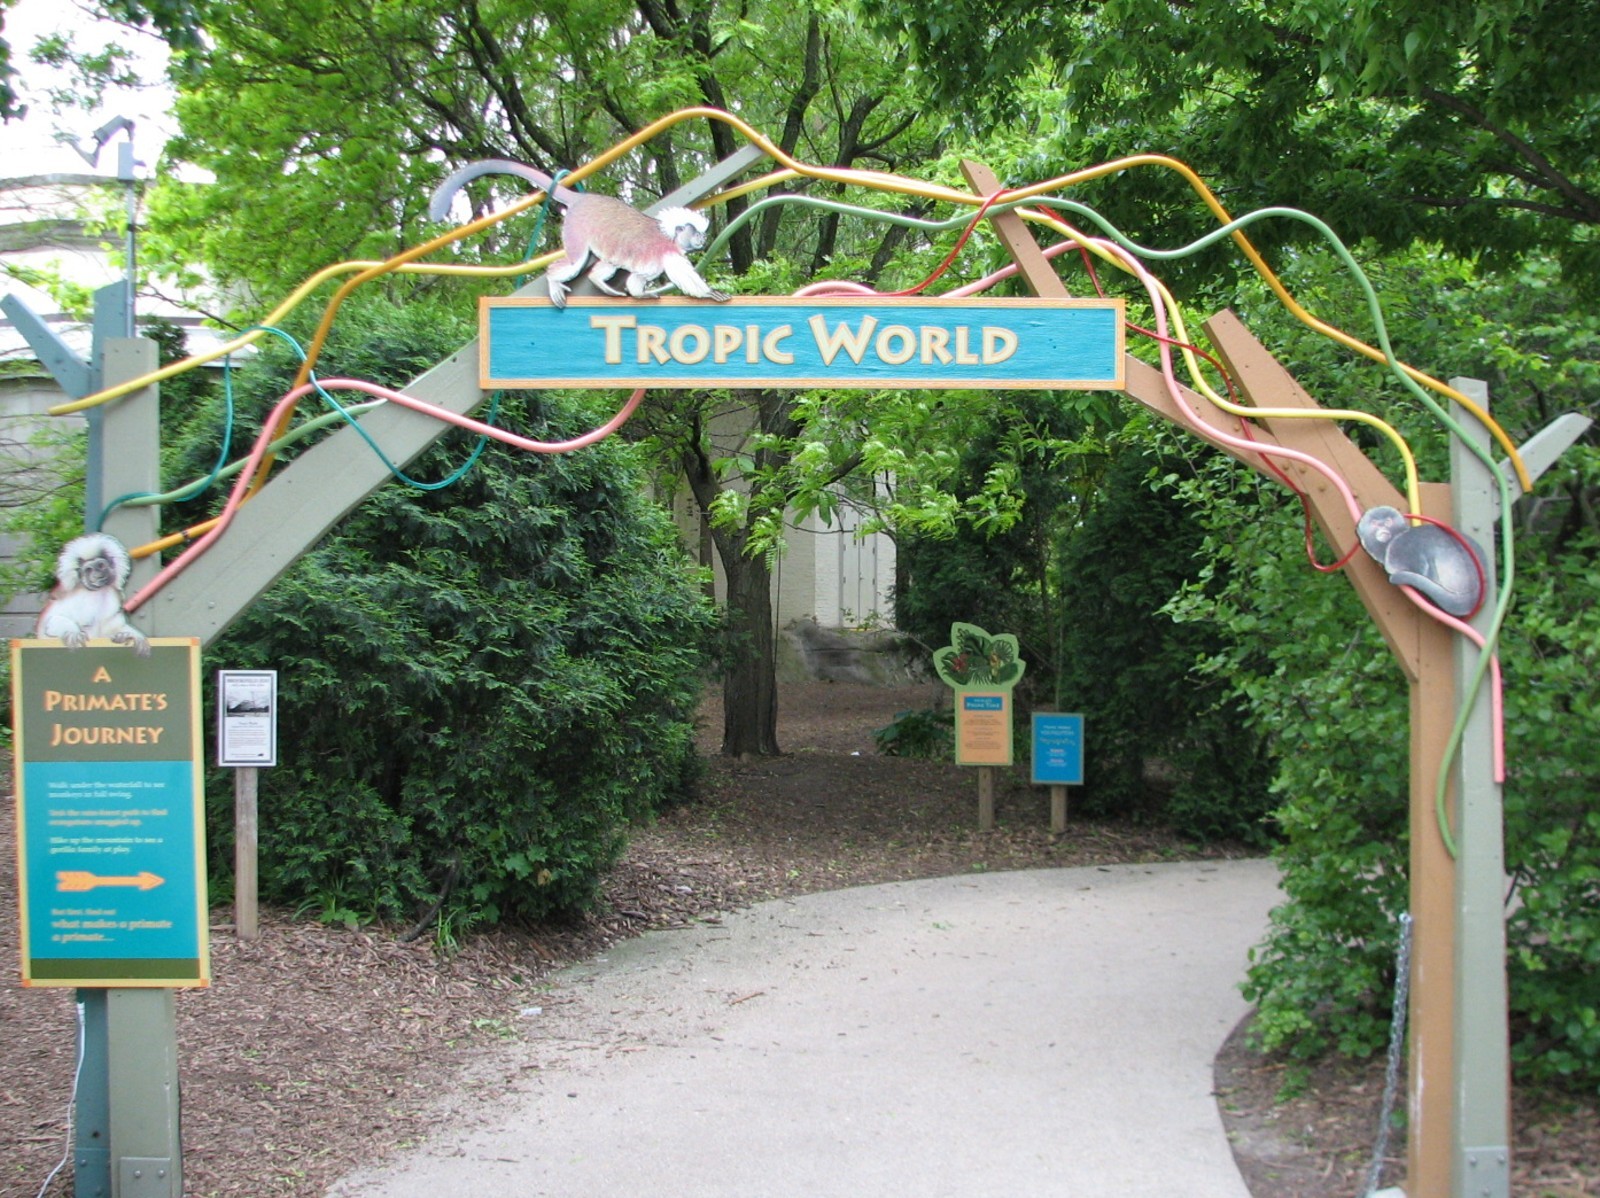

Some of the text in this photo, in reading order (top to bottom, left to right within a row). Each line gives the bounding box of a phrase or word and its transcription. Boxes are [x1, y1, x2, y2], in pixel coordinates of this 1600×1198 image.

[590, 314, 1019, 366] TROPIC WORLD
[93, 666, 112, 683] A
[44, 690, 168, 712] PRIMATE'S
[51, 724, 164, 747] JOURNEY
